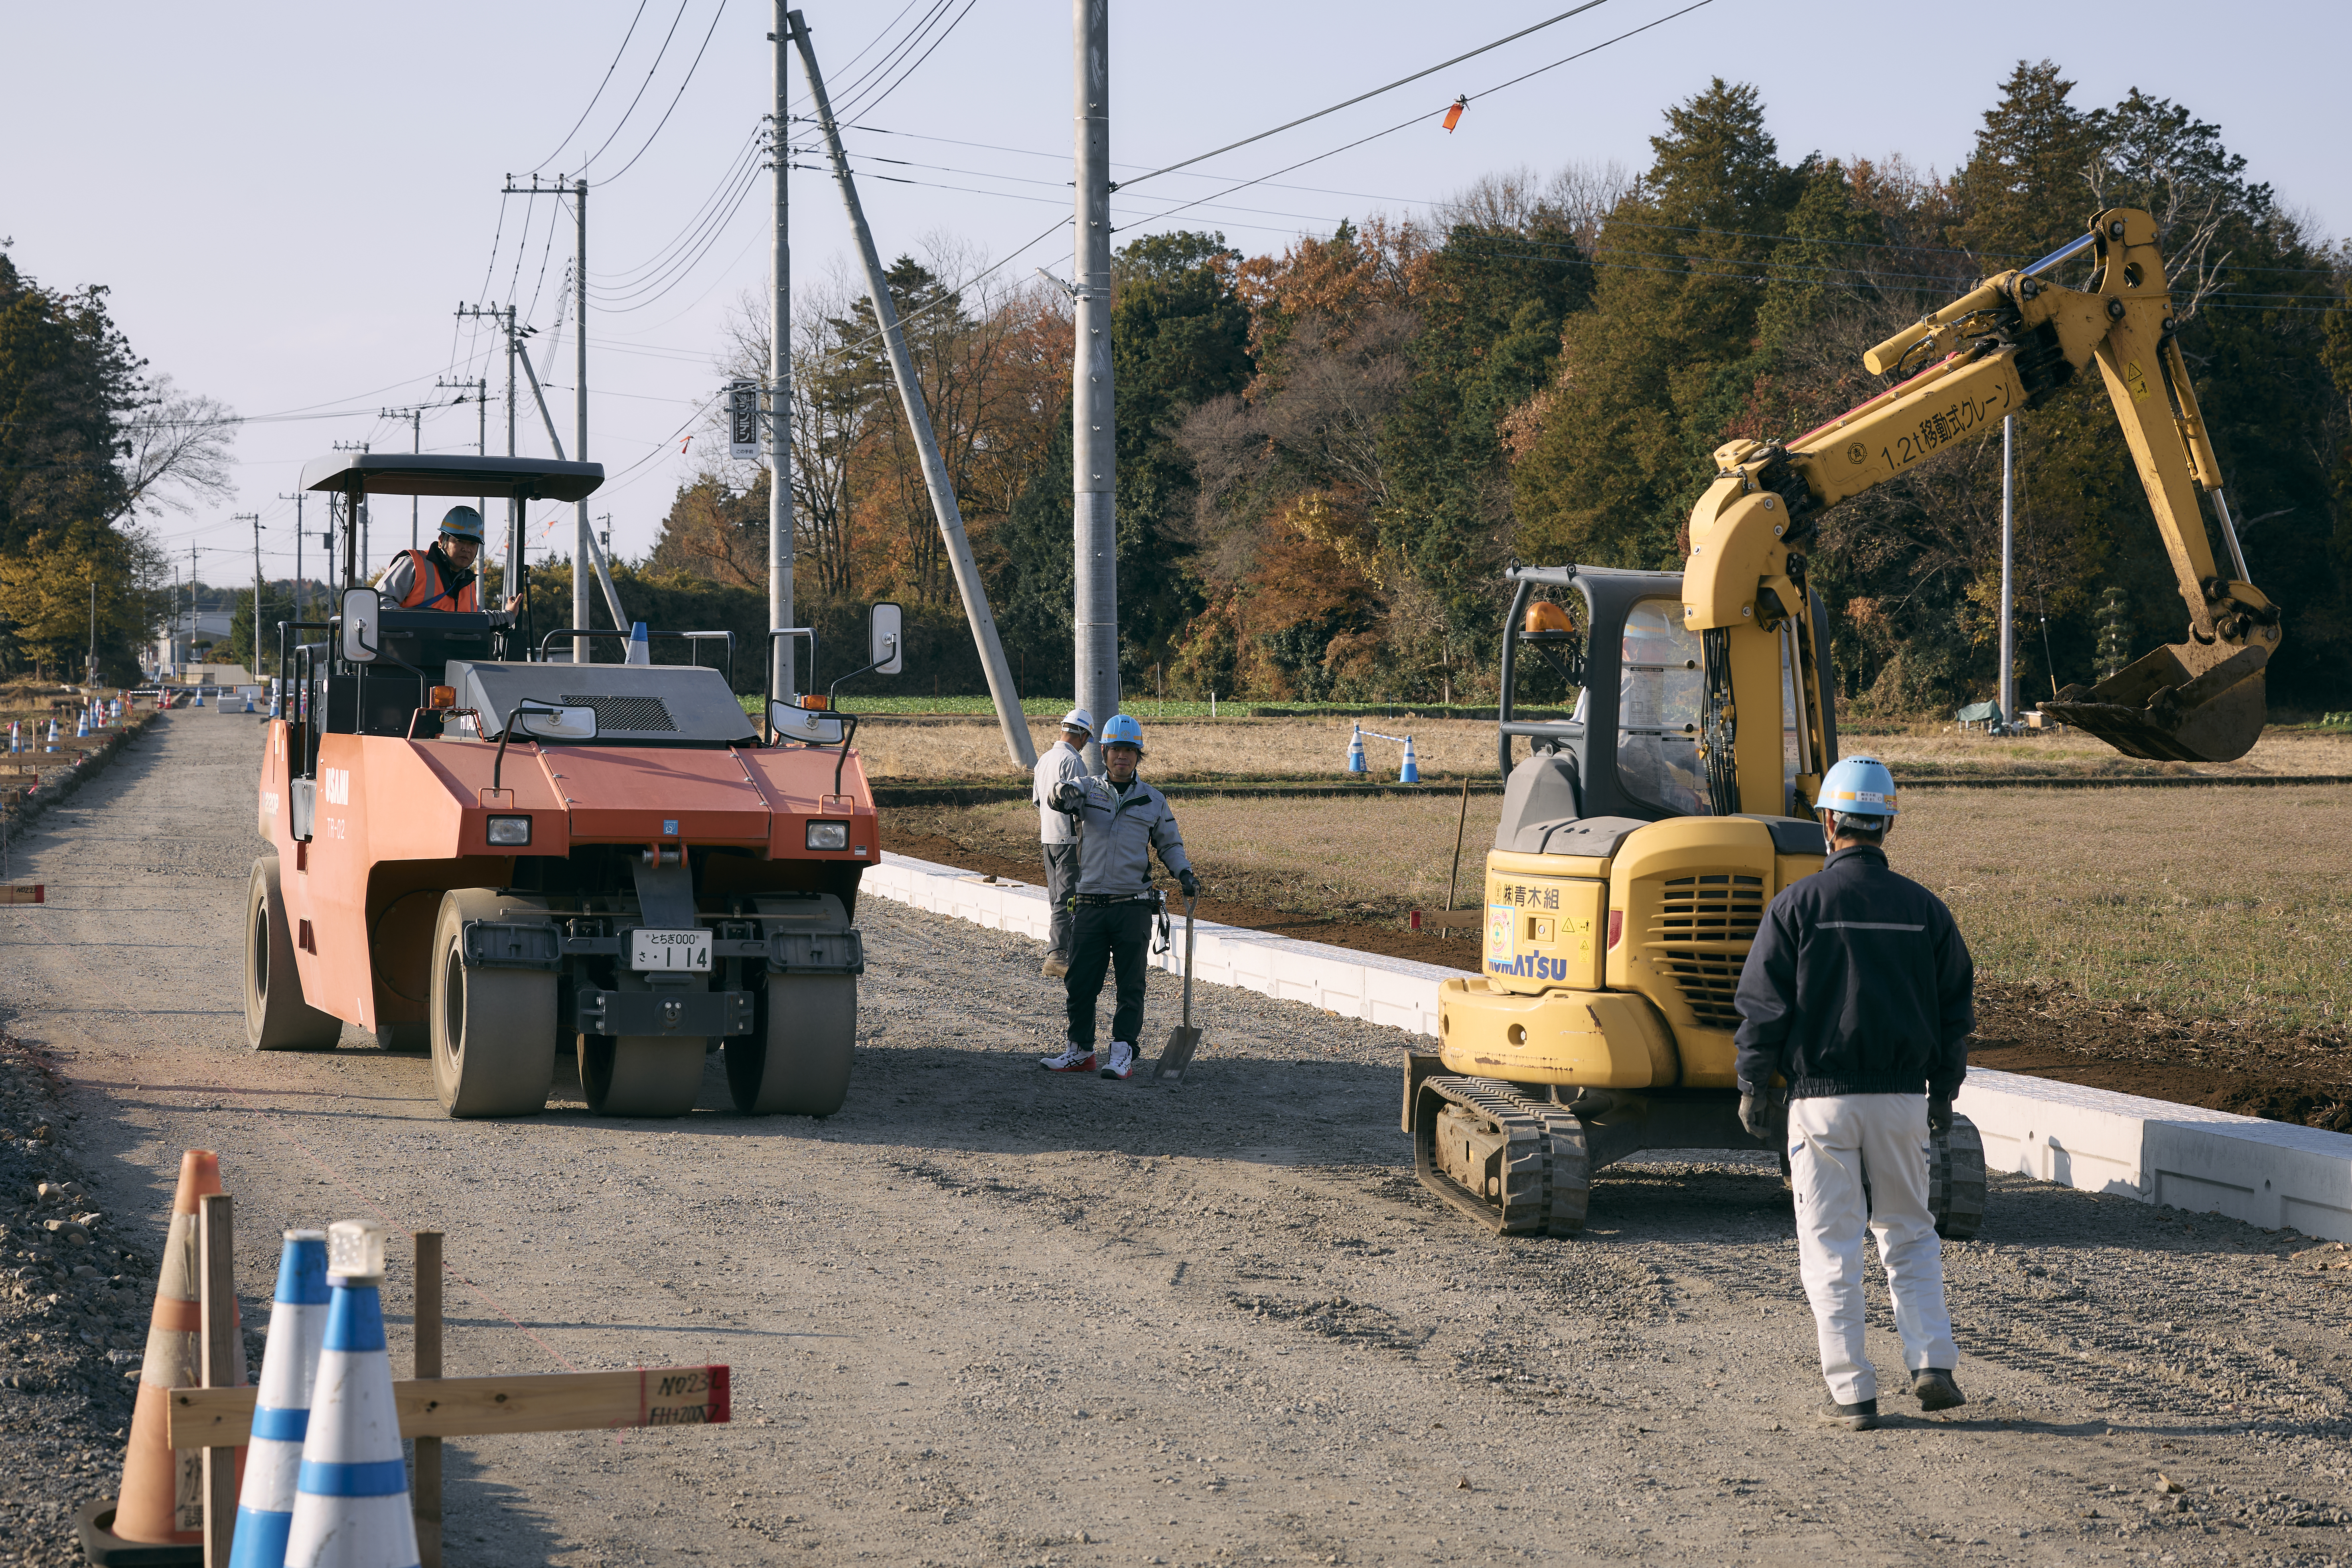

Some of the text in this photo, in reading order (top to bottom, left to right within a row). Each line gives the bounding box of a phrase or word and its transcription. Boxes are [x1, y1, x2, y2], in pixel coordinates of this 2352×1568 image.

[1881, 382, 2010, 470] 1.2t移動式クレーン
[460, 713, 481, 731] HITAC
[325, 767, 349, 806] USAMI
[327, 817, 345, 839] TR-02
[651, 934, 695, 944] とちぎ000
